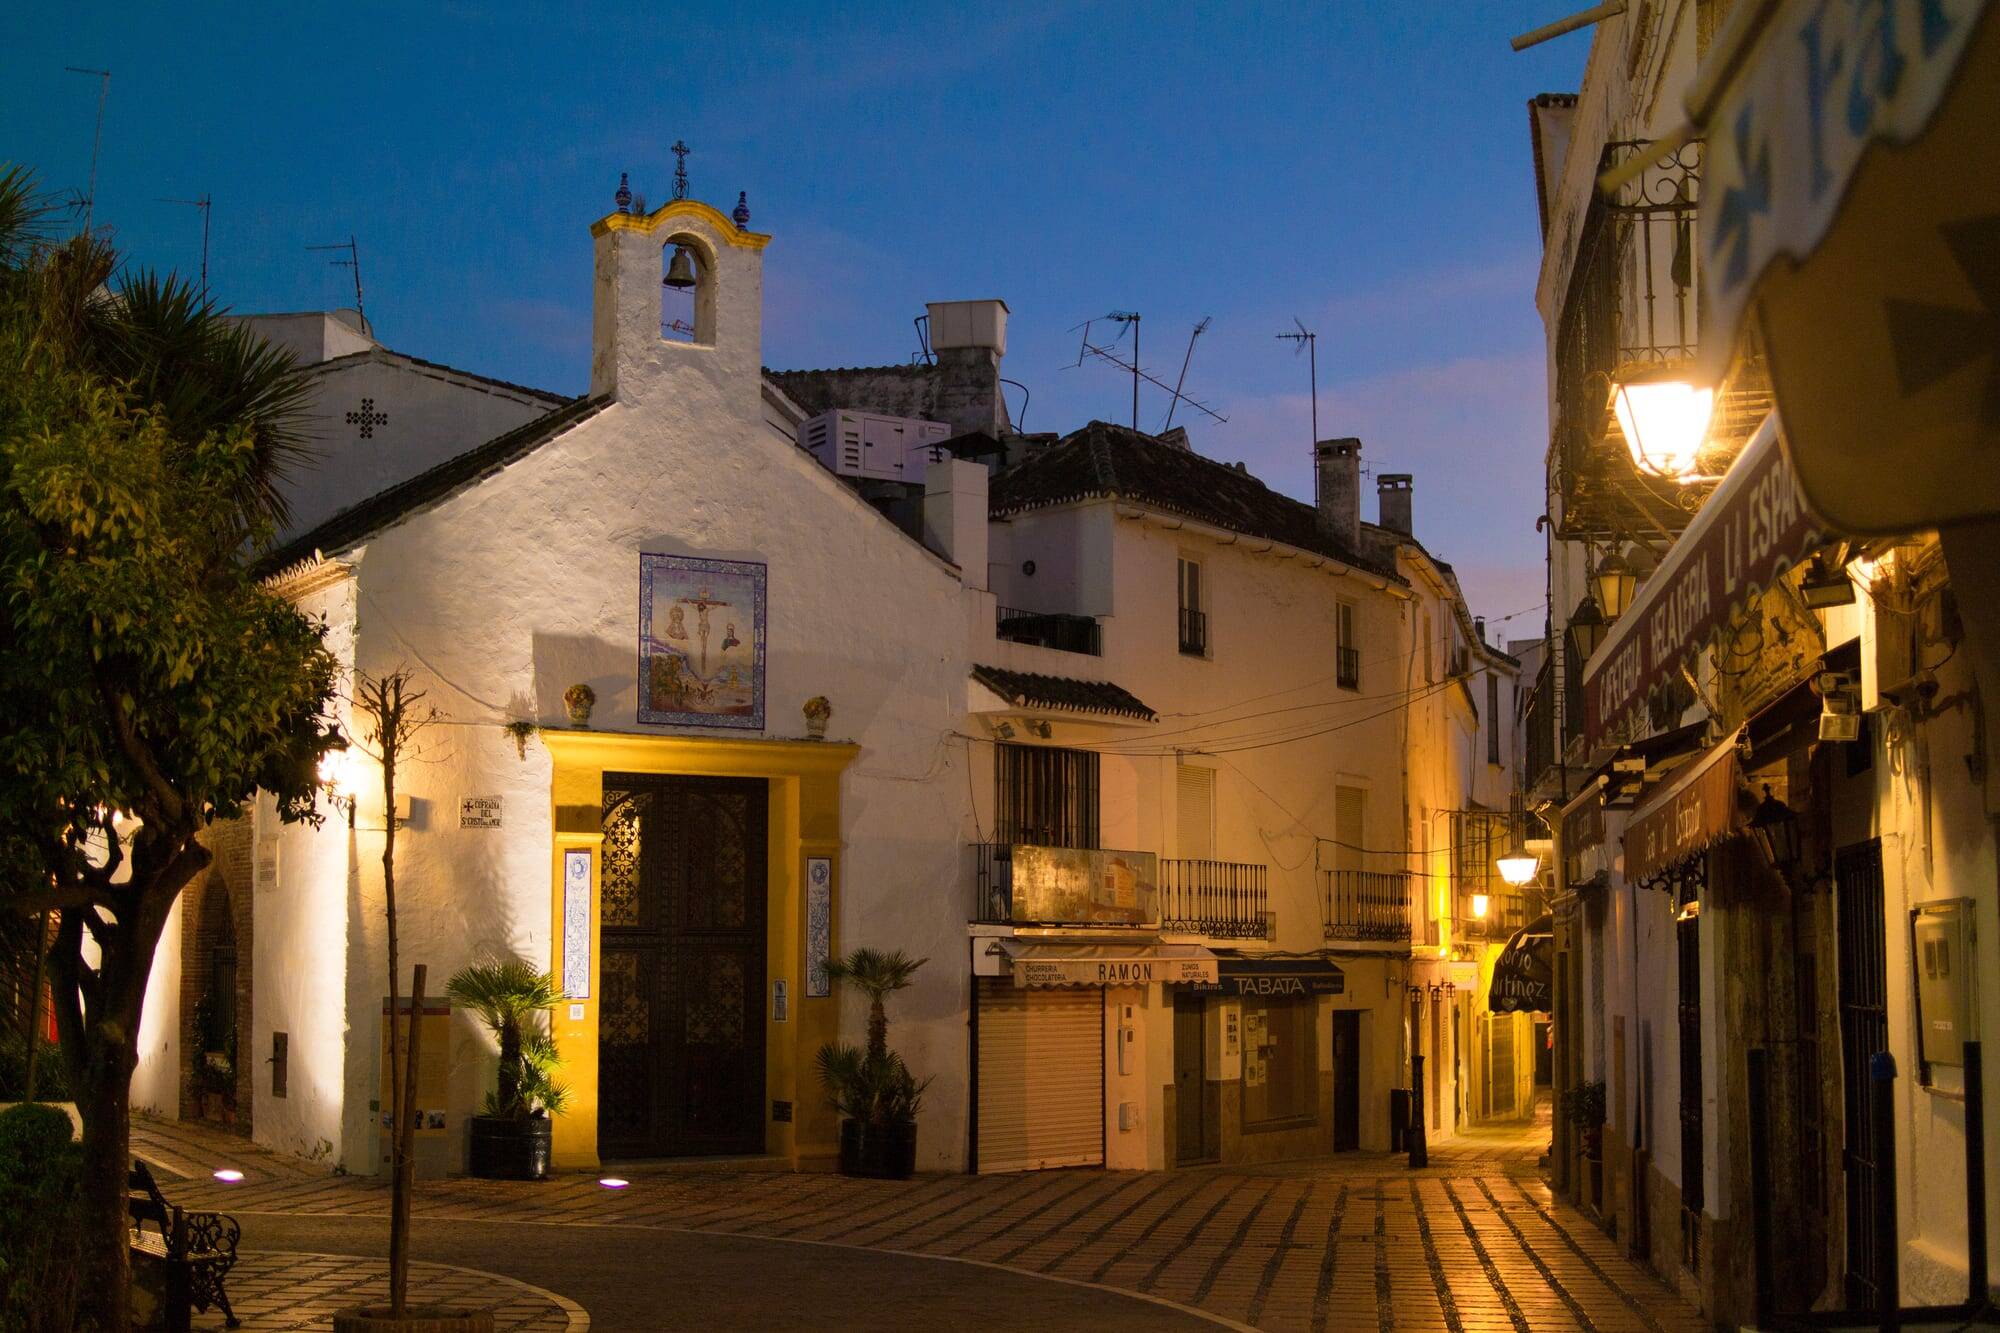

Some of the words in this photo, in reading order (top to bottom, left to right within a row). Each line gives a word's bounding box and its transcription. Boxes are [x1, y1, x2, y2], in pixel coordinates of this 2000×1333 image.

[1725, 510, 1742, 595] LA
[1098, 963, 1152, 981] RAMON
[1233, 977, 1305, 995] TABATA
